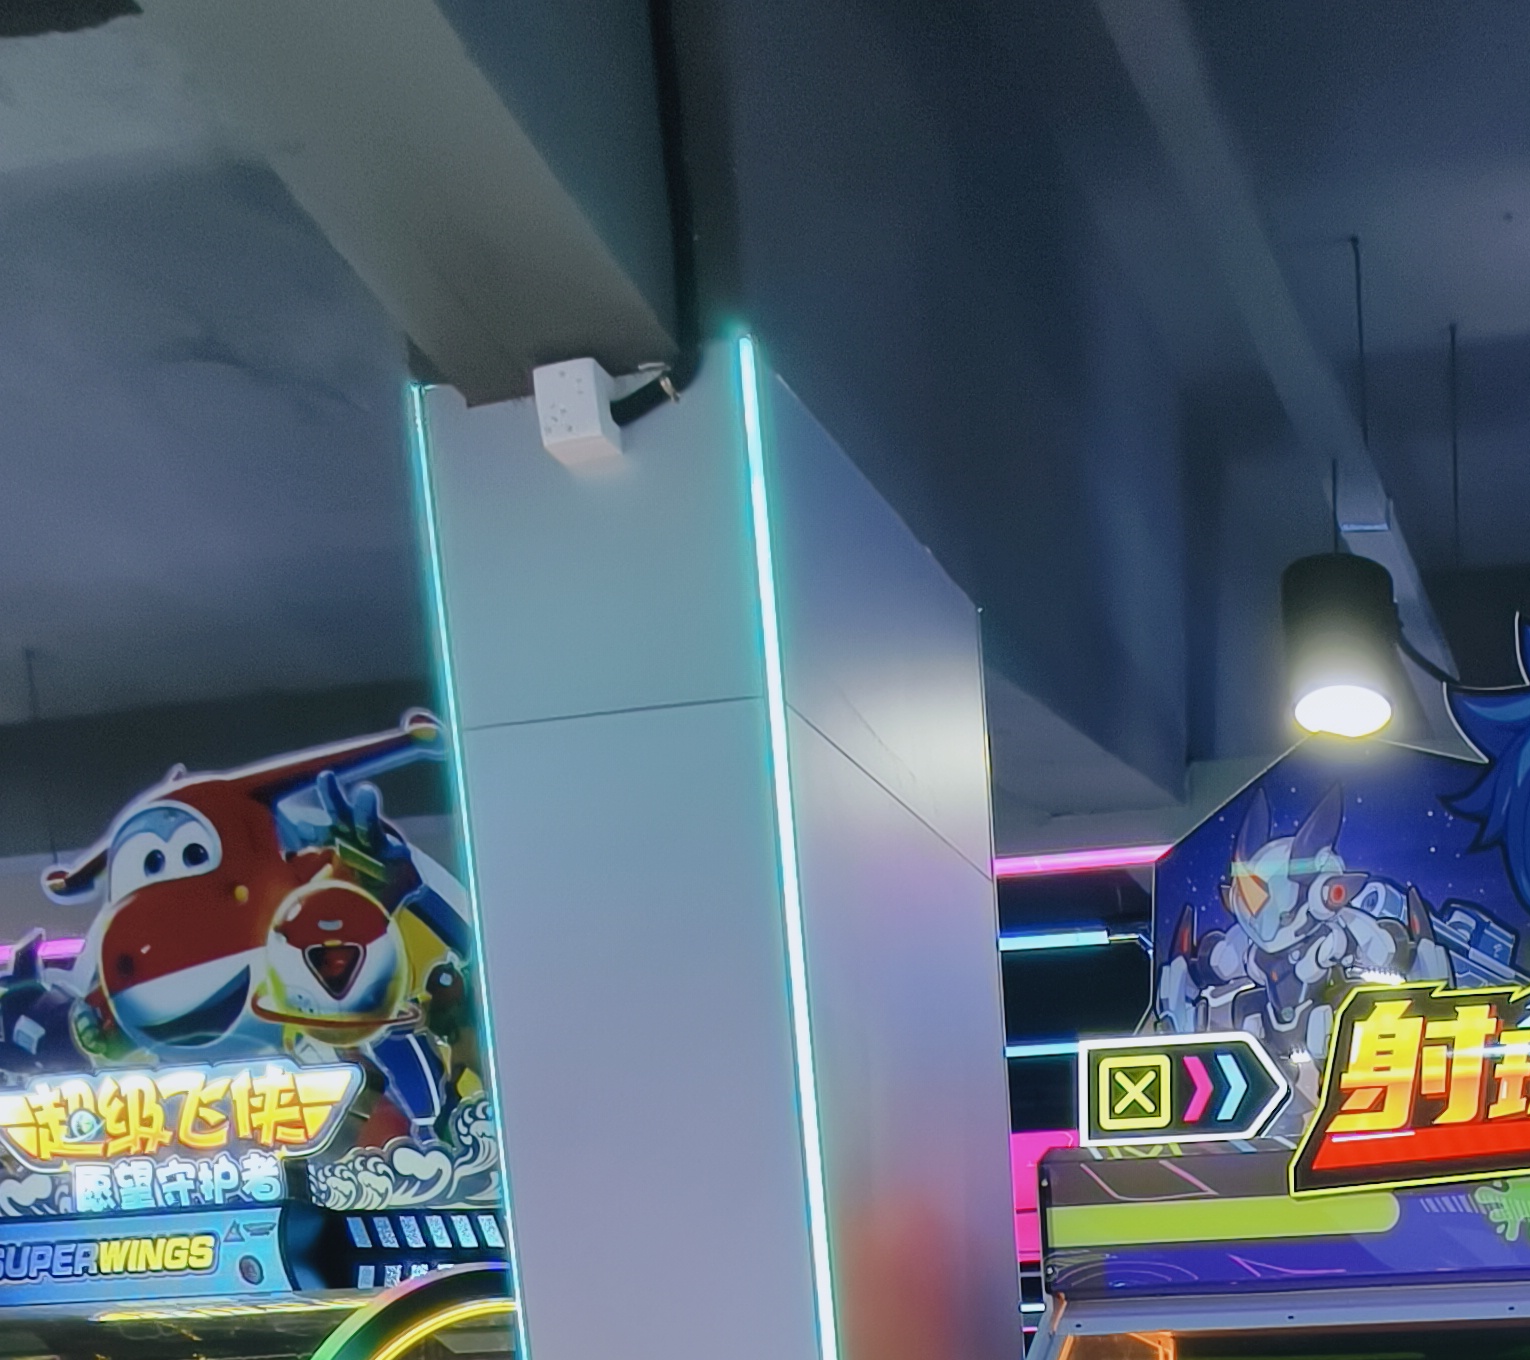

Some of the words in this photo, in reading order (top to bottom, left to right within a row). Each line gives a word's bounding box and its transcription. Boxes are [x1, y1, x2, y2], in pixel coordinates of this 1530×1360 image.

[28, 1065, 310, 1161] 超级飞侠
[0, 1235, 215, 1278] UPERWINGS
